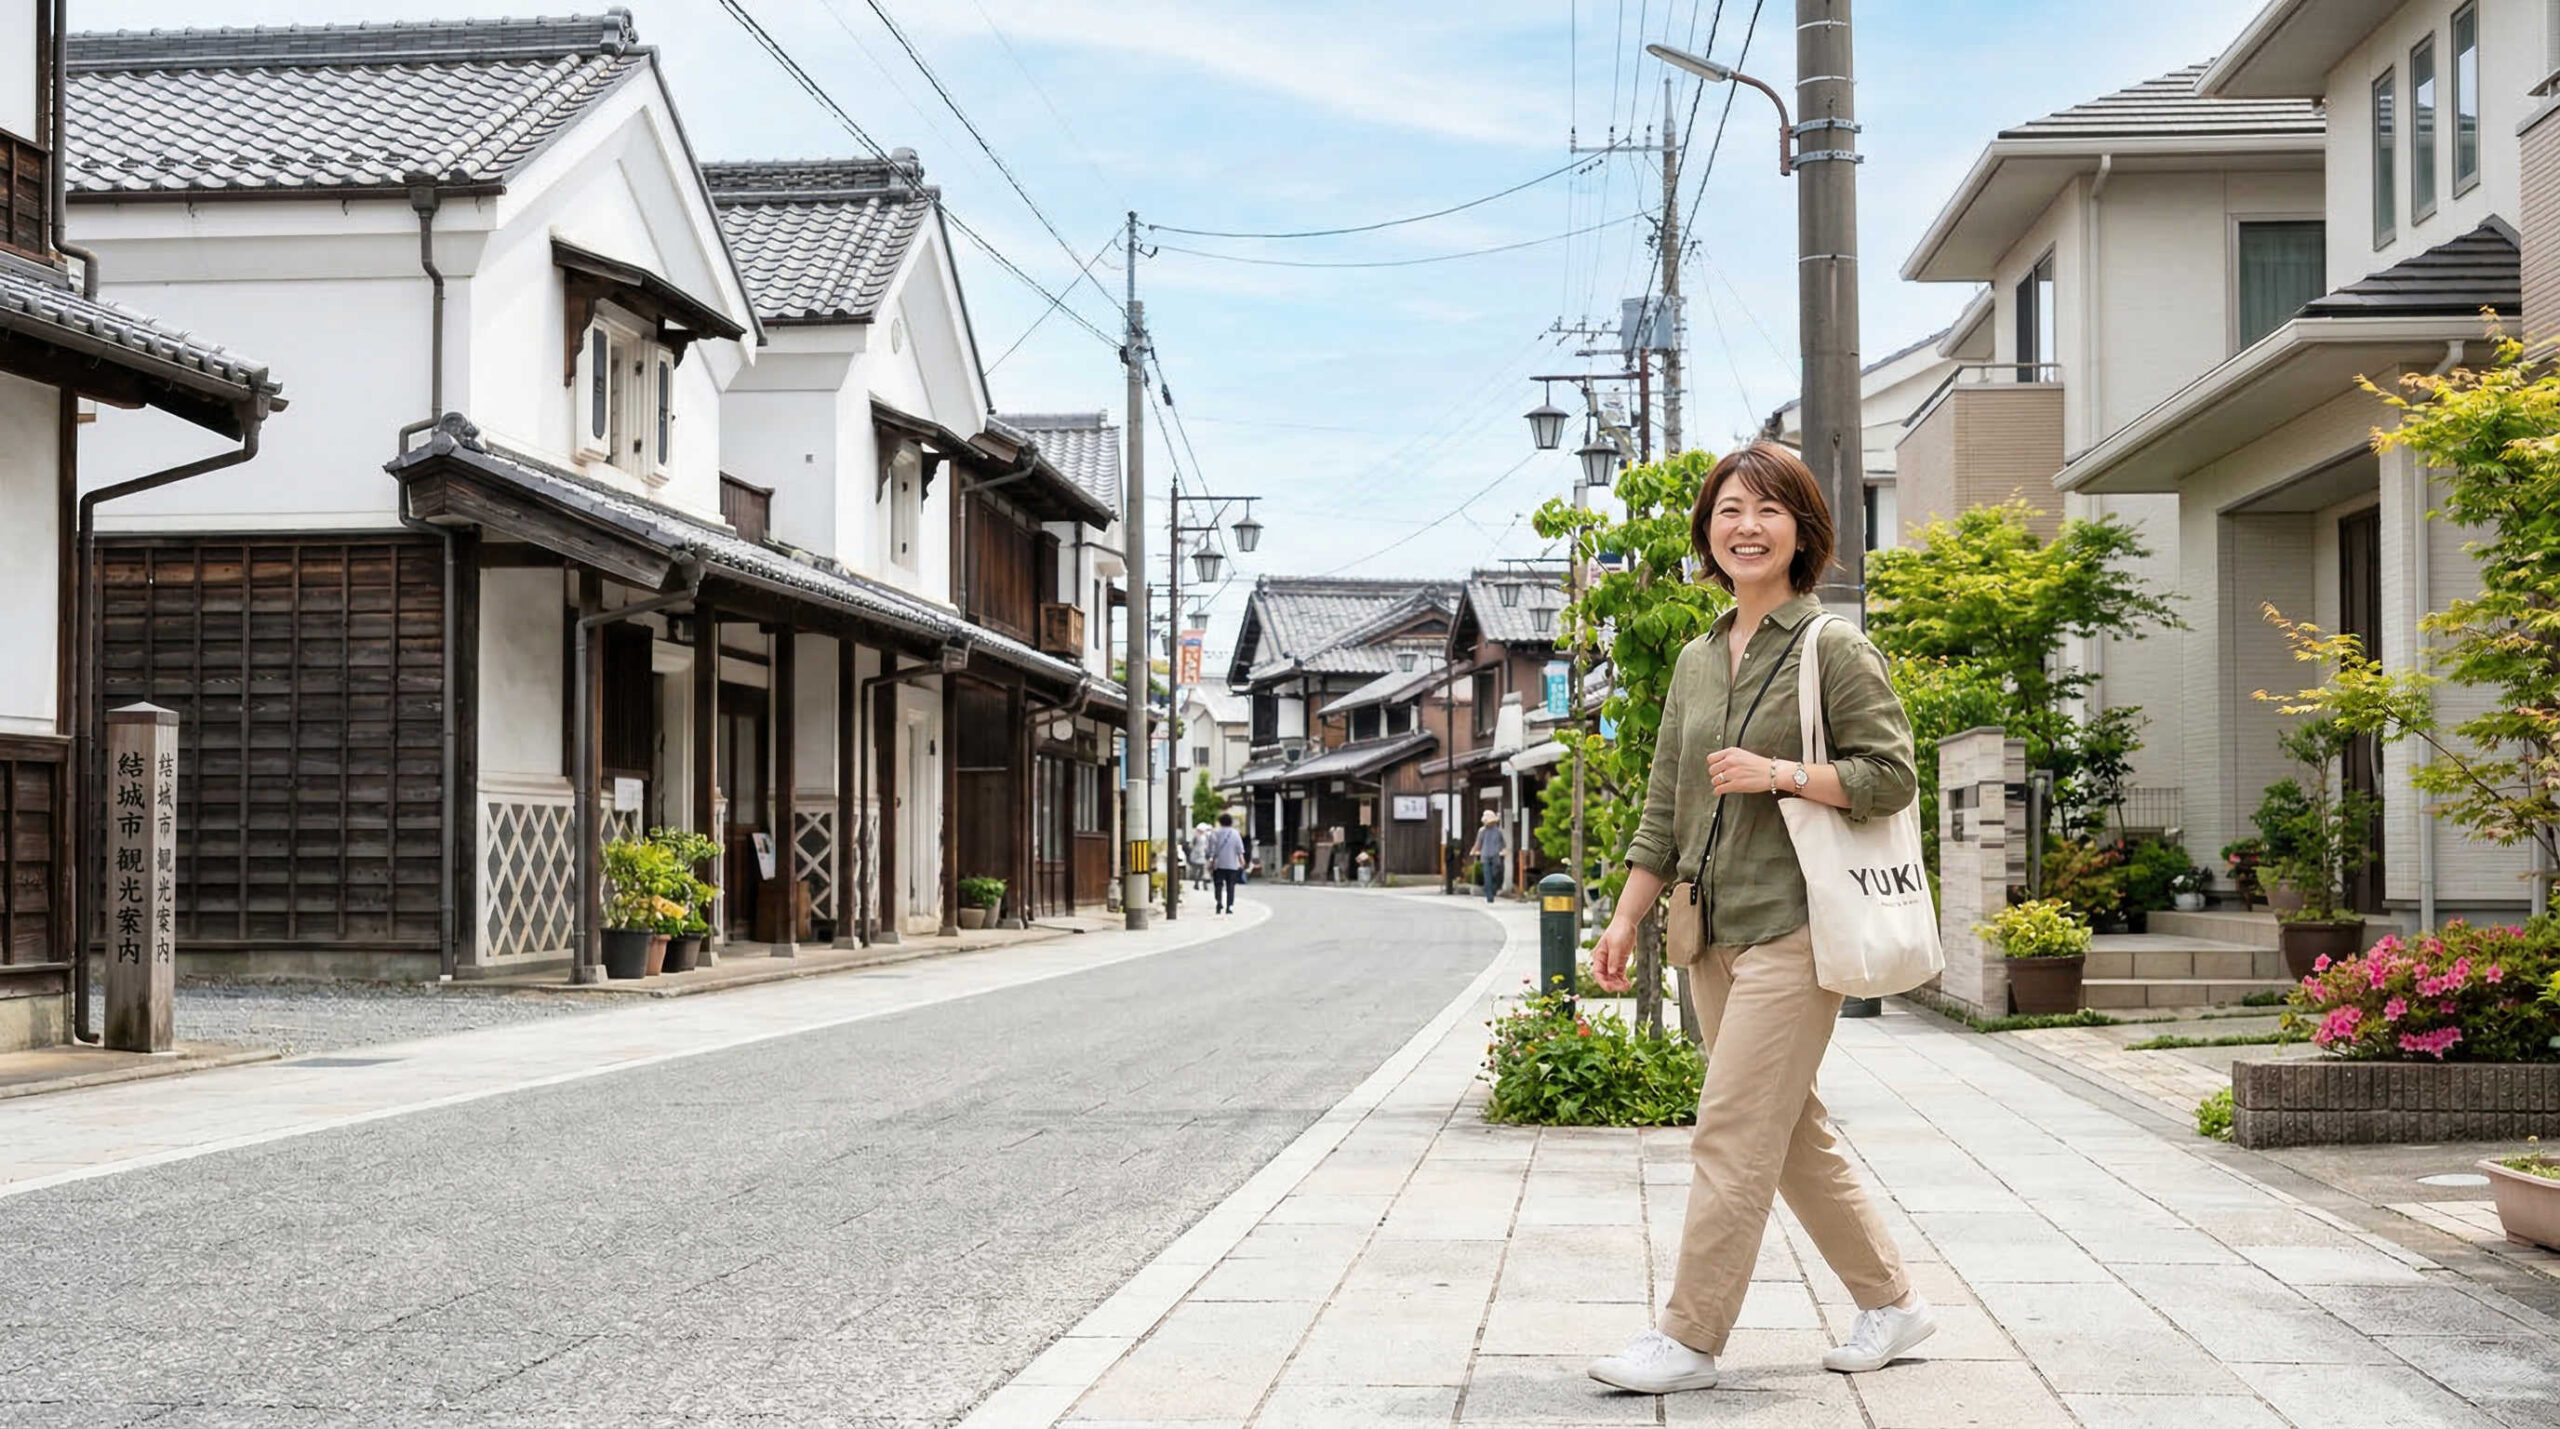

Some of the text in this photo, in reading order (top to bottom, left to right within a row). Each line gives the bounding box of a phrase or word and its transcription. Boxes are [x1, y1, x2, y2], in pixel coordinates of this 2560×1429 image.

[116, 751, 145, 965] 結城市観光案内
[1848, 863, 1923, 896] YUKI
